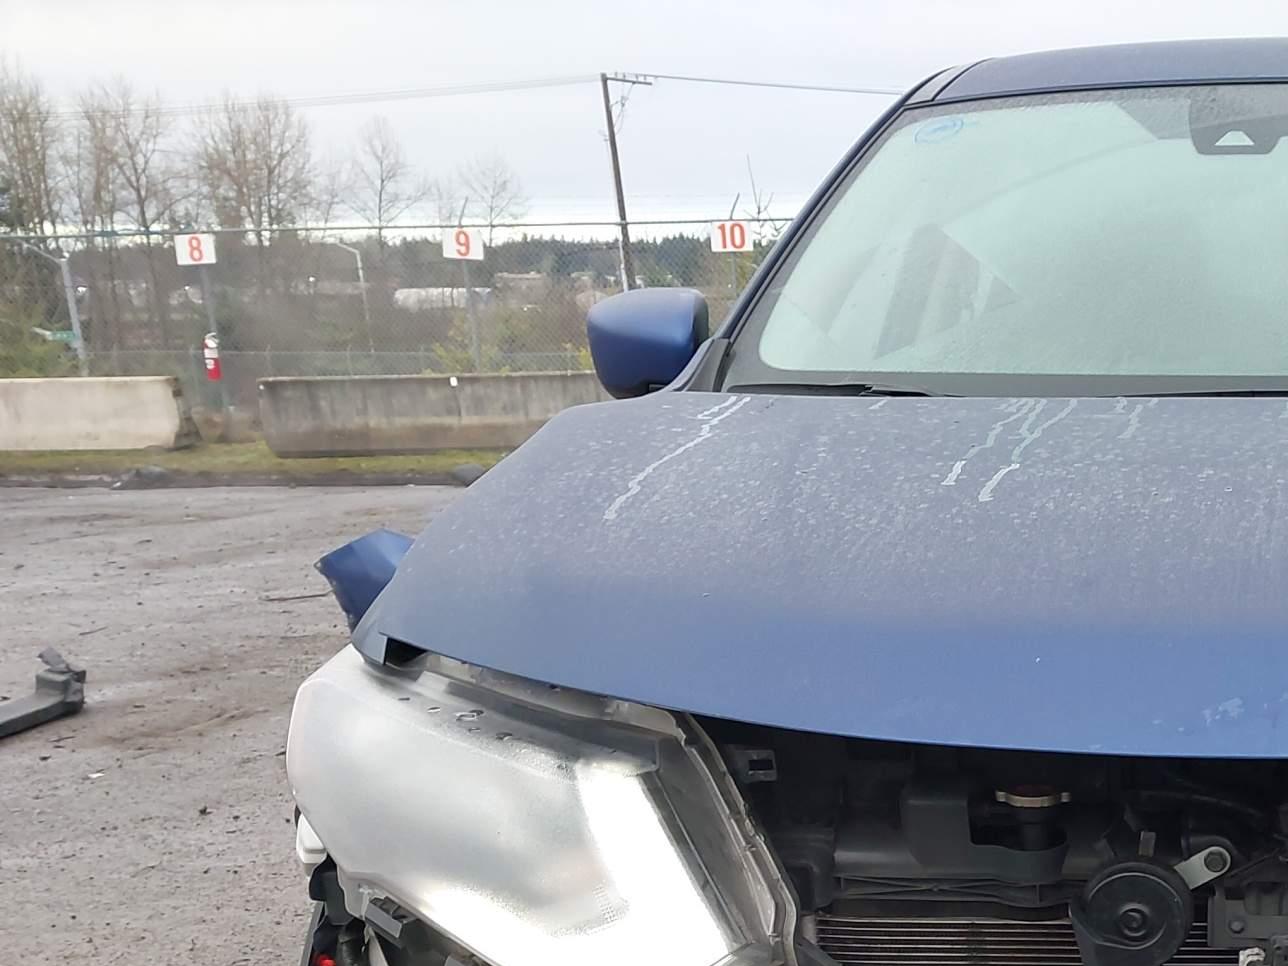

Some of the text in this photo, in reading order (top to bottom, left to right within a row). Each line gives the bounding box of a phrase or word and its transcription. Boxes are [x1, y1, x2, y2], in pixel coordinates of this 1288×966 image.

[187, 235, 204, 262] 8
[455, 230, 471, 257] 9
[719, 222, 747, 250] 10
